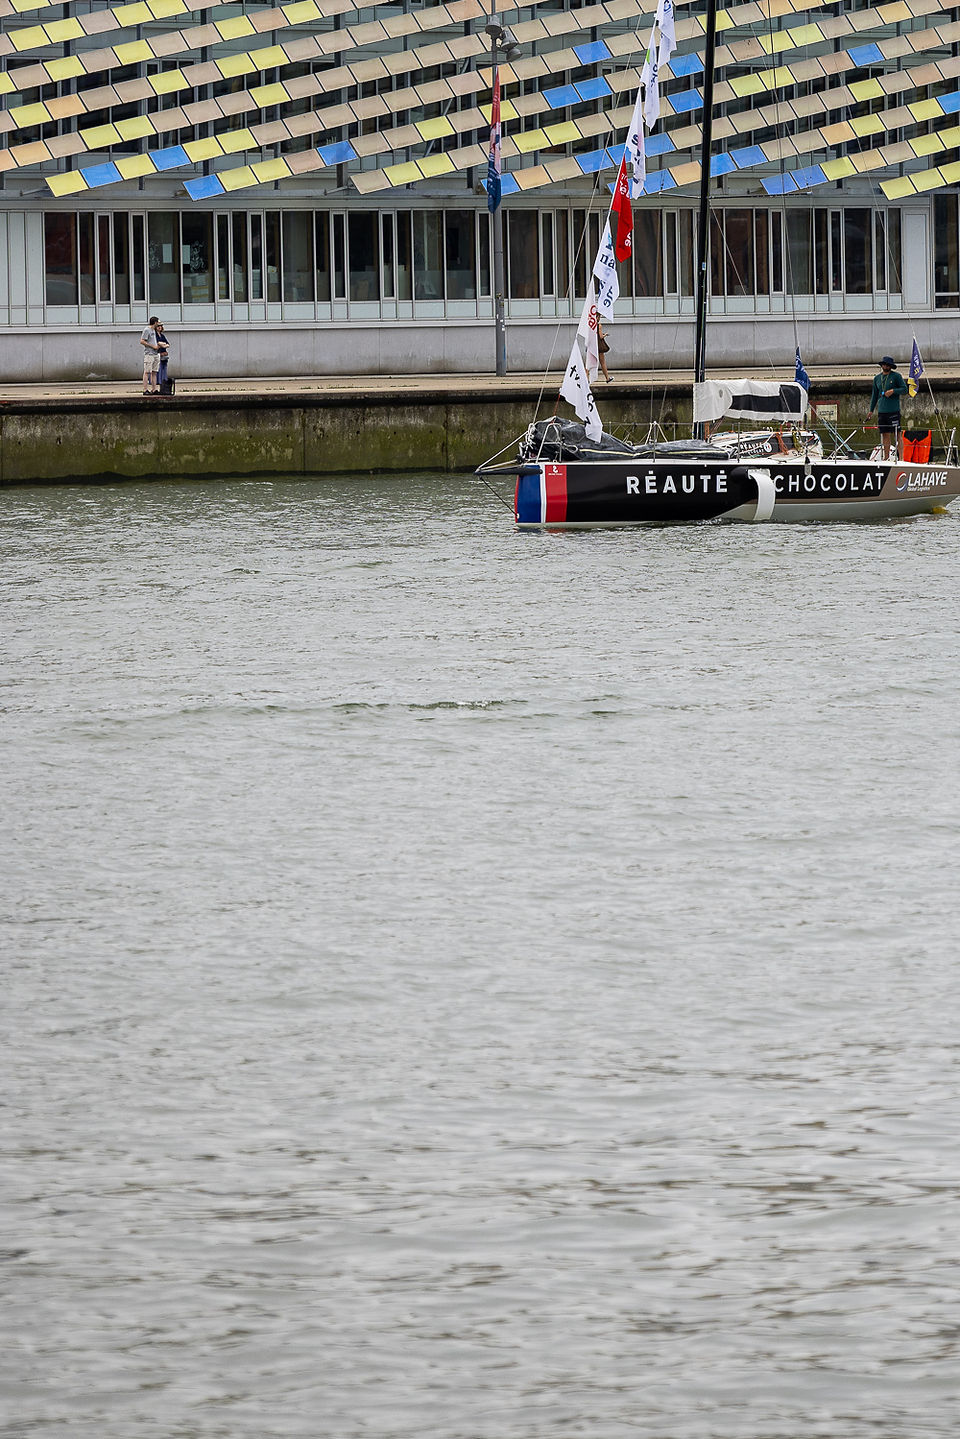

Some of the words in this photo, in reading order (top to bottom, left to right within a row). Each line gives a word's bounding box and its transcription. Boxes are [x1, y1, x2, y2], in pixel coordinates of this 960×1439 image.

[626, 469, 728, 494] RÉAUTÉ
[773, 472, 885, 492] CHOCOLAT
[908, 471, 948, 486] LAHAYE
